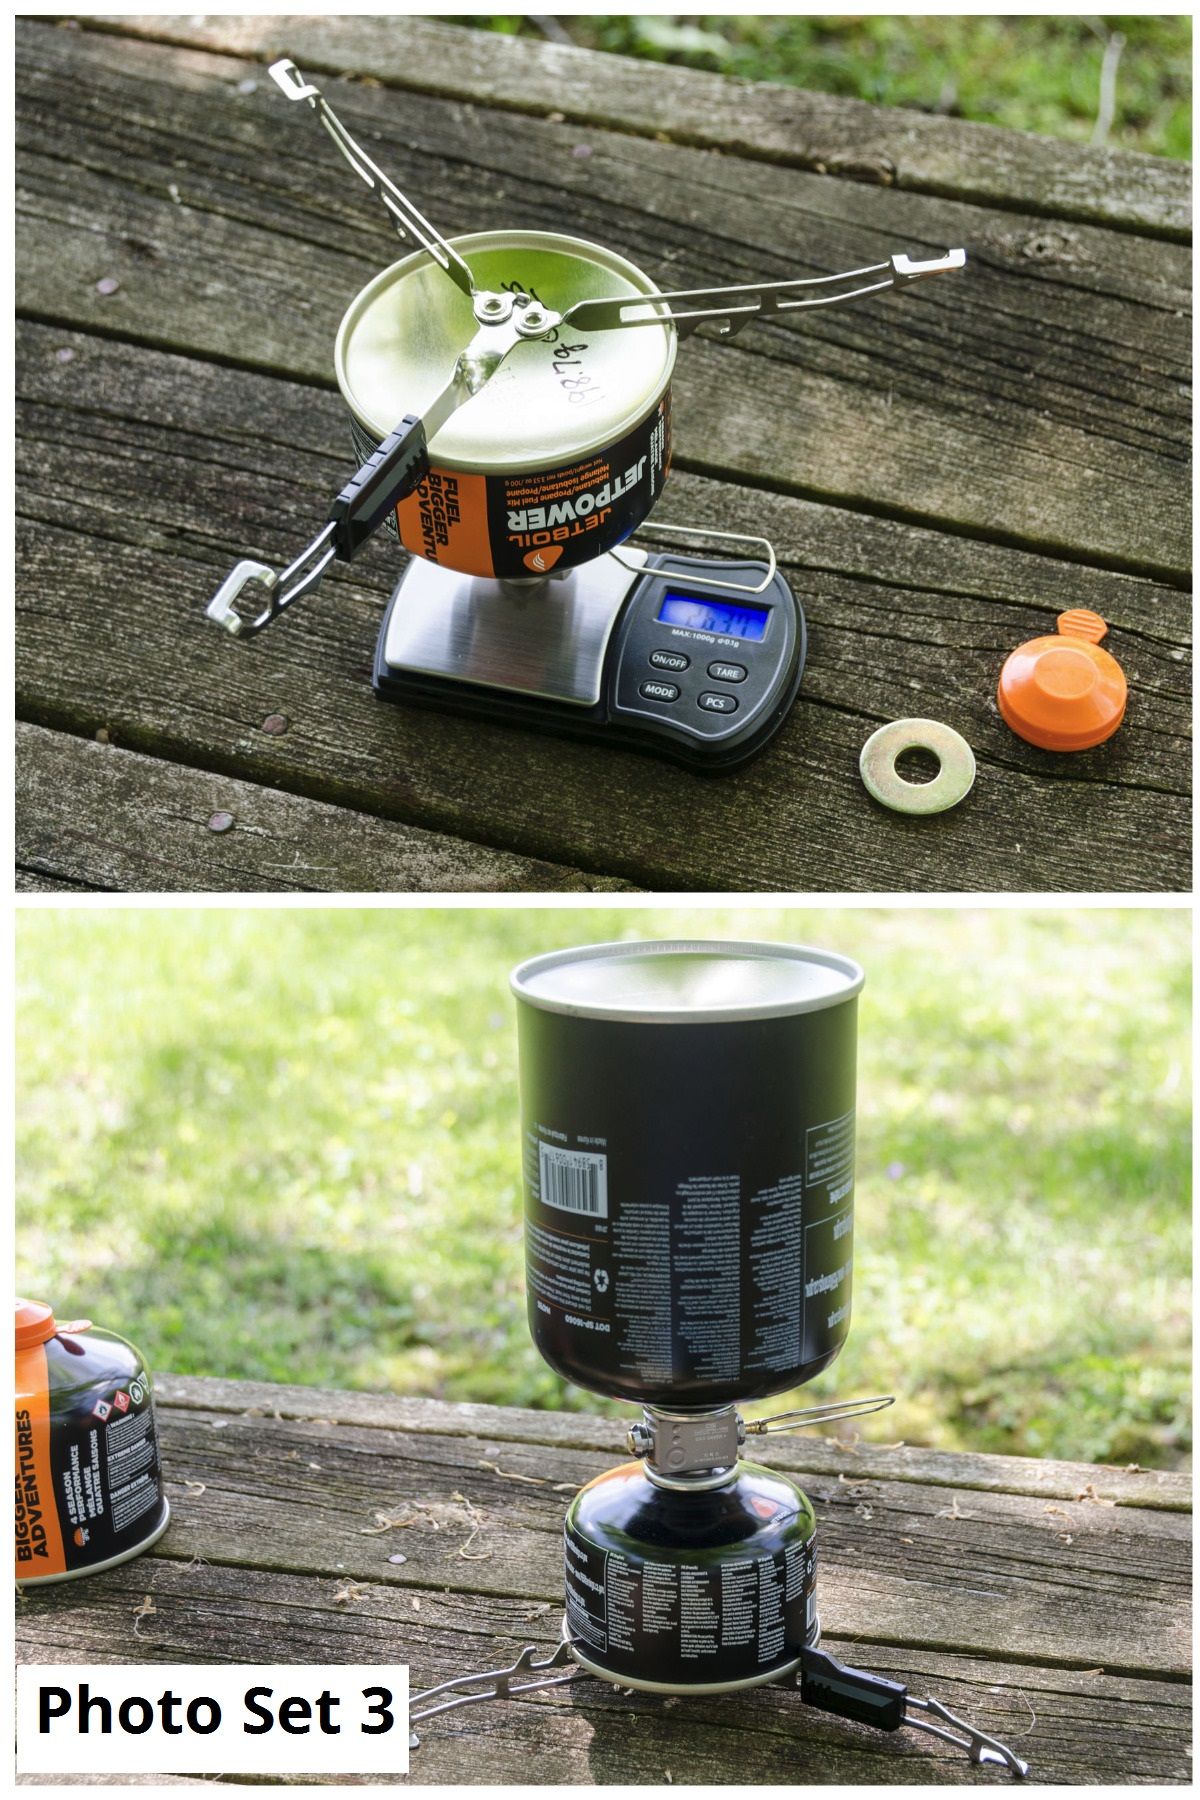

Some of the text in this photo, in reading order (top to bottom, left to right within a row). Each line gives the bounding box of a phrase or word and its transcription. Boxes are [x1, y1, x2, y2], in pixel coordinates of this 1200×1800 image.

[442, 476, 461, 527] FUEL
[506, 476, 578, 497] Isobutane/Propane
[506, 472, 610, 507] Isobutane/Propane Fuel Mix
[506, 455, 648, 531] JETPOWER
[416, 480, 438, 562] DVENTU
[427, 473, 449, 546] BIGGER
[508, 507, 612, 547] JETBOIL
[652, 654, 688, 668] ON/OFF
[716, 667, 740, 678] TARE
[645, 684, 675, 698] MODE
[706, 697, 725, 708] PCS
[595, 1322, 611, 1333] DOT
[90, 1429, 104, 1515] QUATRE SAISONS
[107, 1448, 131, 1462] EXTREME
[16, 1409, 49, 1558] ADVENTURES
[63, 1471, 78, 1525] 4 SEASON
[70, 1444, 87, 1522] PERFORMANCE
[83, 1466, 97, 1518] MÉLANGE
[110, 1484, 130, 1500] DANGER
